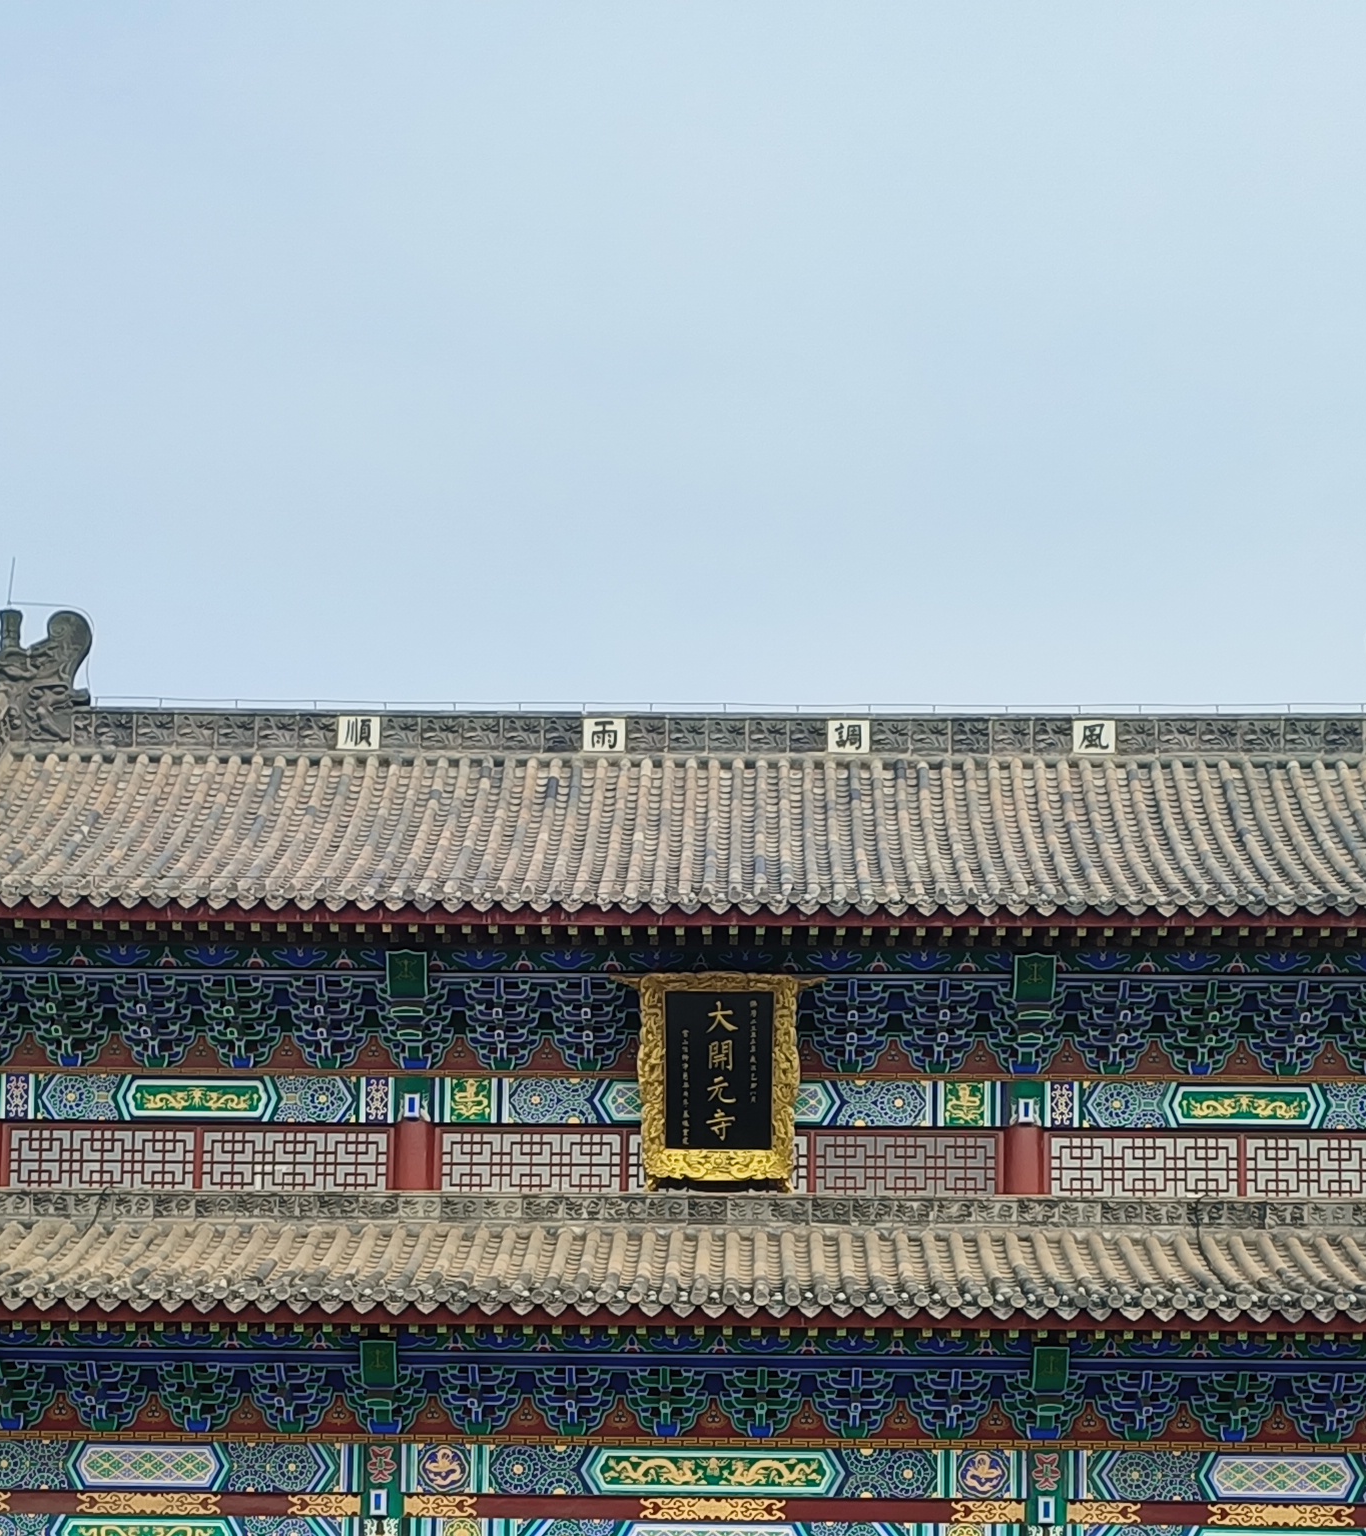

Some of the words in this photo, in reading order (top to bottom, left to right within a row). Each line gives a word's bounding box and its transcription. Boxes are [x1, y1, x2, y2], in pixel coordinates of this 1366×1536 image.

[342, 717, 374, 749] 順
[589, 721, 620, 750] 雨
[834, 723, 863, 752] 調
[1079, 724, 1109, 752] 風
[705, 1000, 739, 1142] 大開元寺
